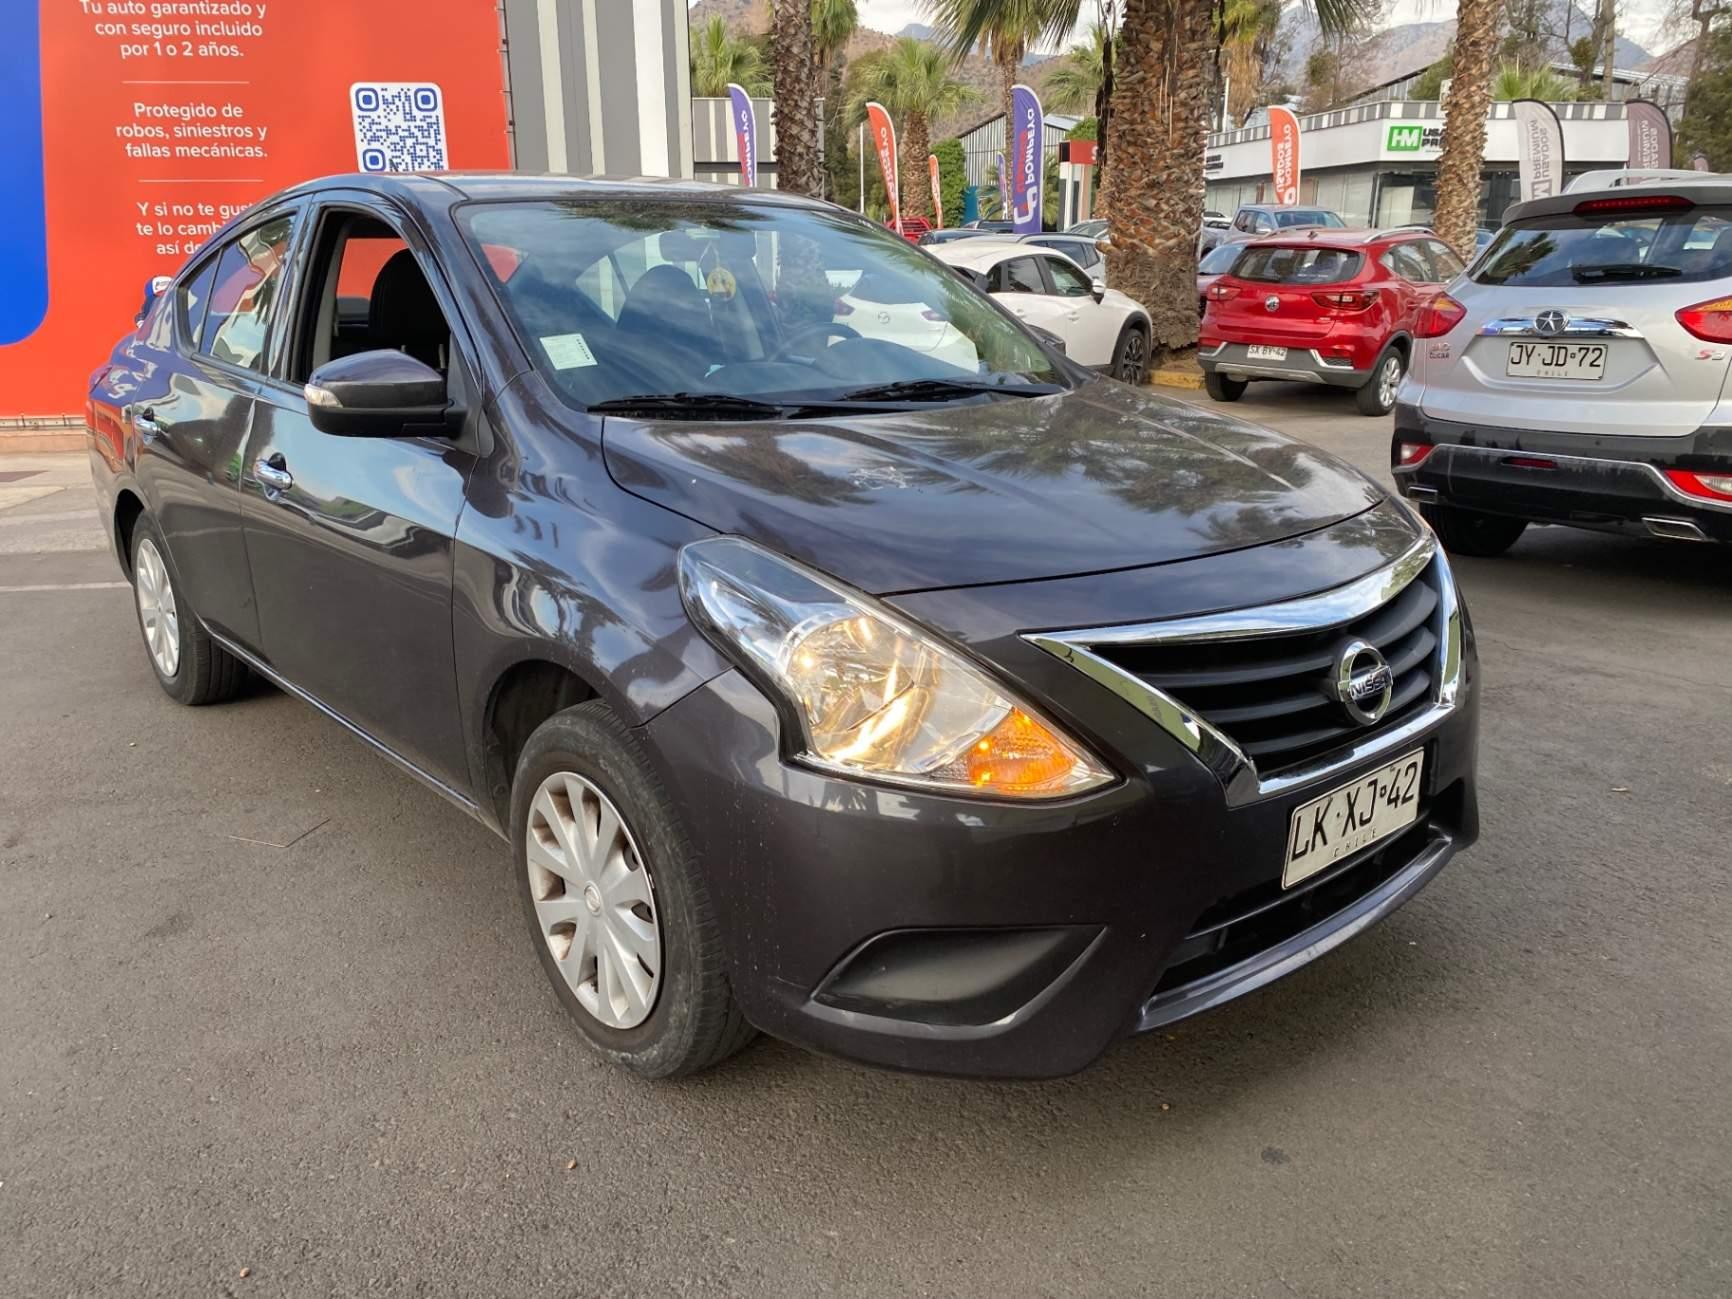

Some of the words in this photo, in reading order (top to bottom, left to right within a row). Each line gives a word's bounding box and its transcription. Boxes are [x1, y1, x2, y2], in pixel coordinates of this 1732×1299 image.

[79, 0, 102, 15] Tu
[107, 1, 146, 15] auto
[150, 0, 252, 18] garantizado
[255, 4, 266, 19] y
[94, 23, 127, 36] con
[131, 23, 191, 39] seguro
[195, 20, 263, 36] incluido
[120, 44, 149, 60] por
[153, 41, 162, 56] 1
[166, 44, 178, 57] o
[181, 41, 194, 57] 2
[198, 41, 245, 57] años.
[133, 102, 217, 120] Protegido
[221, 103, 243, 117] de
[115, 123, 170, 139] robos,
[173, 122, 254, 138] siniestros
[257, 126, 267, 141] y
[125, 142, 171, 158] fallas
[175, 142, 268, 158] mecánicas.
[136, 202, 149, 216] Y
[154, 202, 168, 216] si
[172, 204, 194, 216] no
[197, 203, 215, 216] te
[219, 202, 253, 219] gus
[136, 222, 154, 236] te
[157, 221, 174, 236] lo
[177, 220, 226, 236] camb
[156, 240, 180, 255] así
